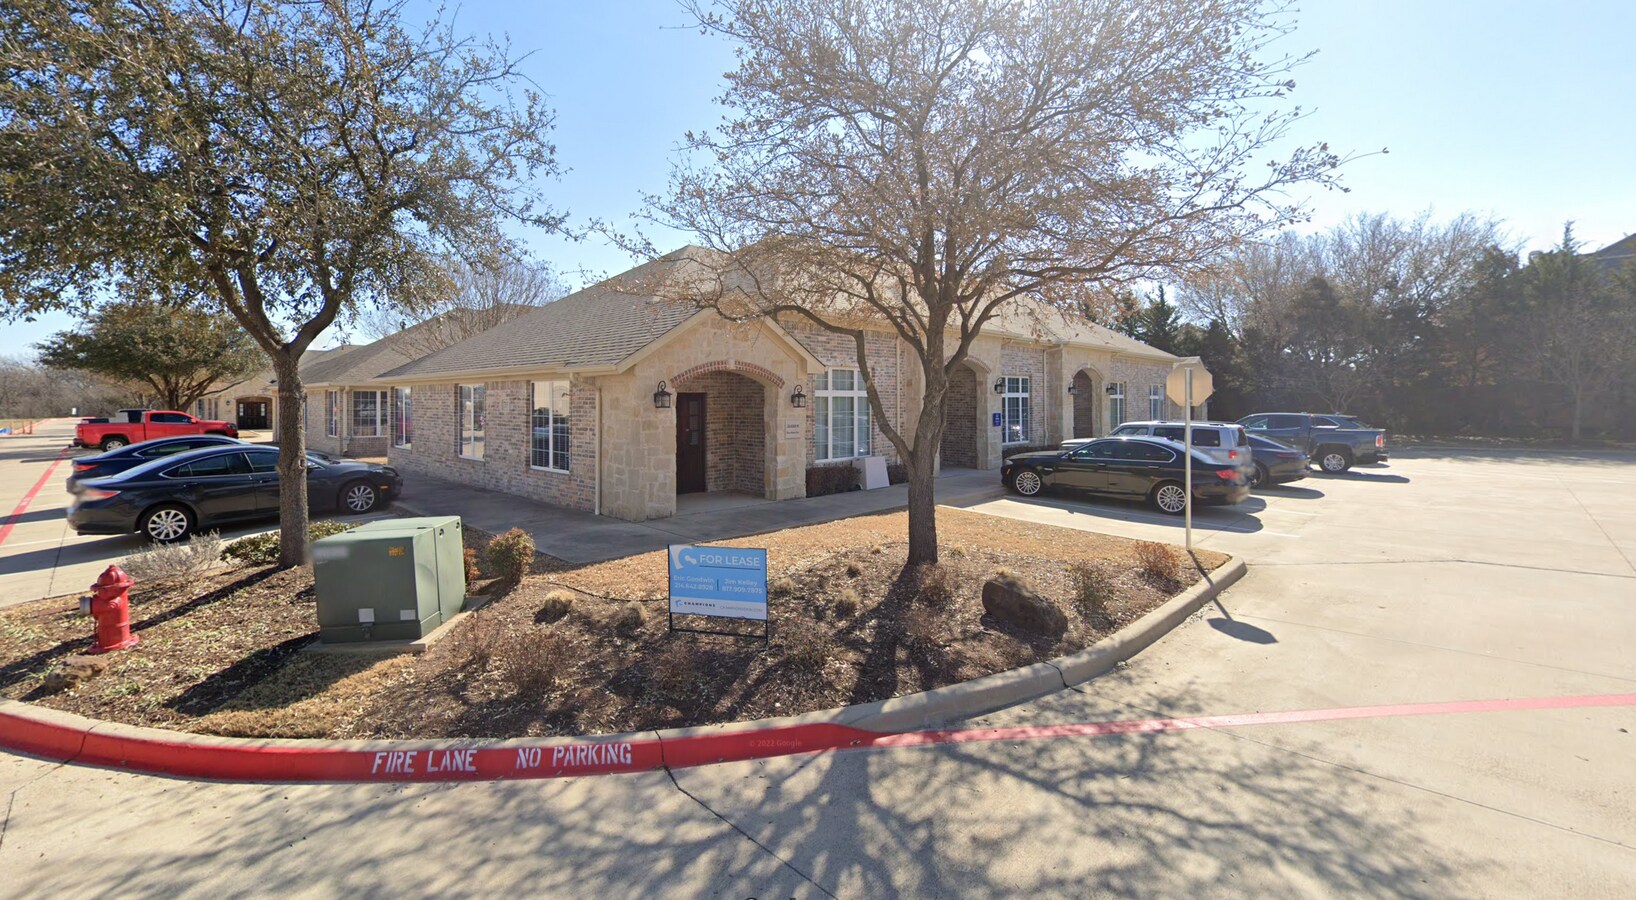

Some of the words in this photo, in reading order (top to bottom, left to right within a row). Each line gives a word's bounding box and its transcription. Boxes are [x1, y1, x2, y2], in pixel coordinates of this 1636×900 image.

[699, 554, 722, 564] FOR
[725, 556, 760, 567] LEASE
[371, 750, 417, 774] FIRE
[427, 749, 478, 773] LANE
[515, 748, 542, 769] NO
[552, 743, 632, 768] PARKING
